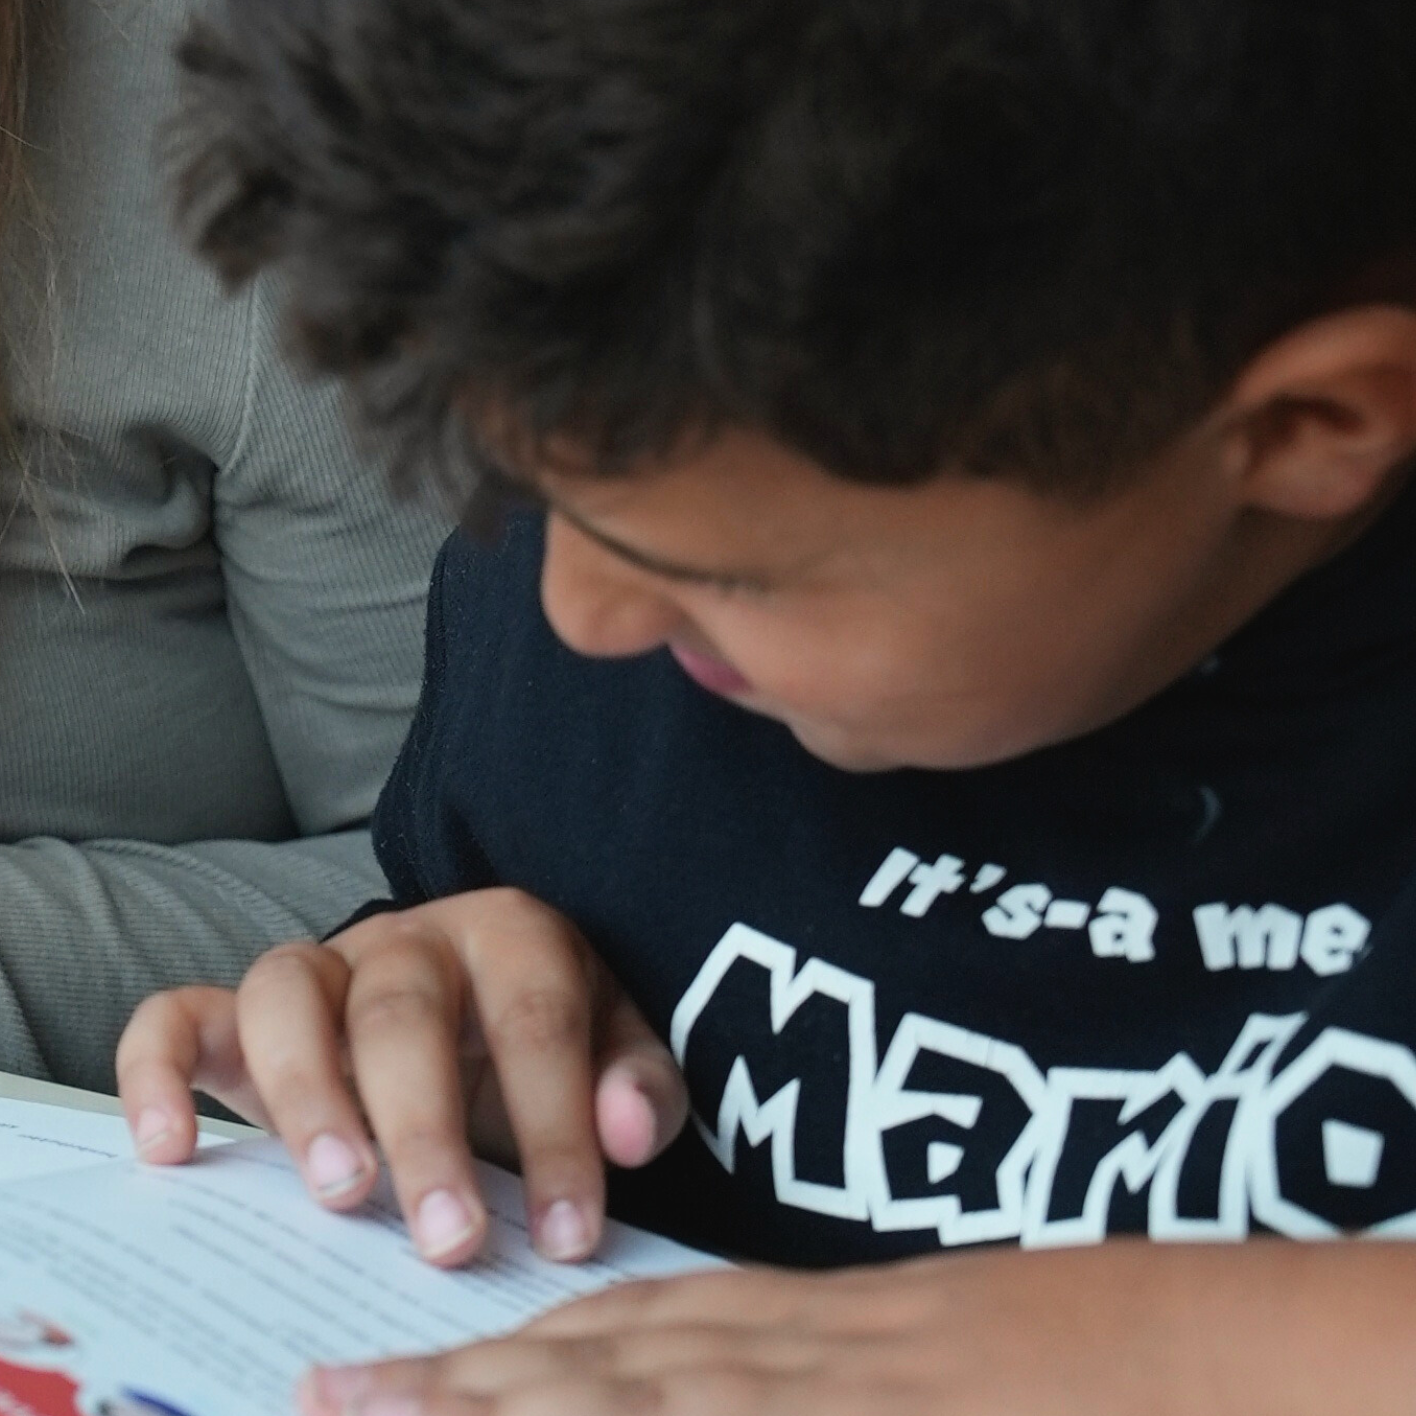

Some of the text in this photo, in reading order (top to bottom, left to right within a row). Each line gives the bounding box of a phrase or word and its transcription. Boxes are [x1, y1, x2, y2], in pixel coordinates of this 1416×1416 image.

[858, 847, 1374, 977] It's-a me
[670, 921, 1416, 1251] Mario
